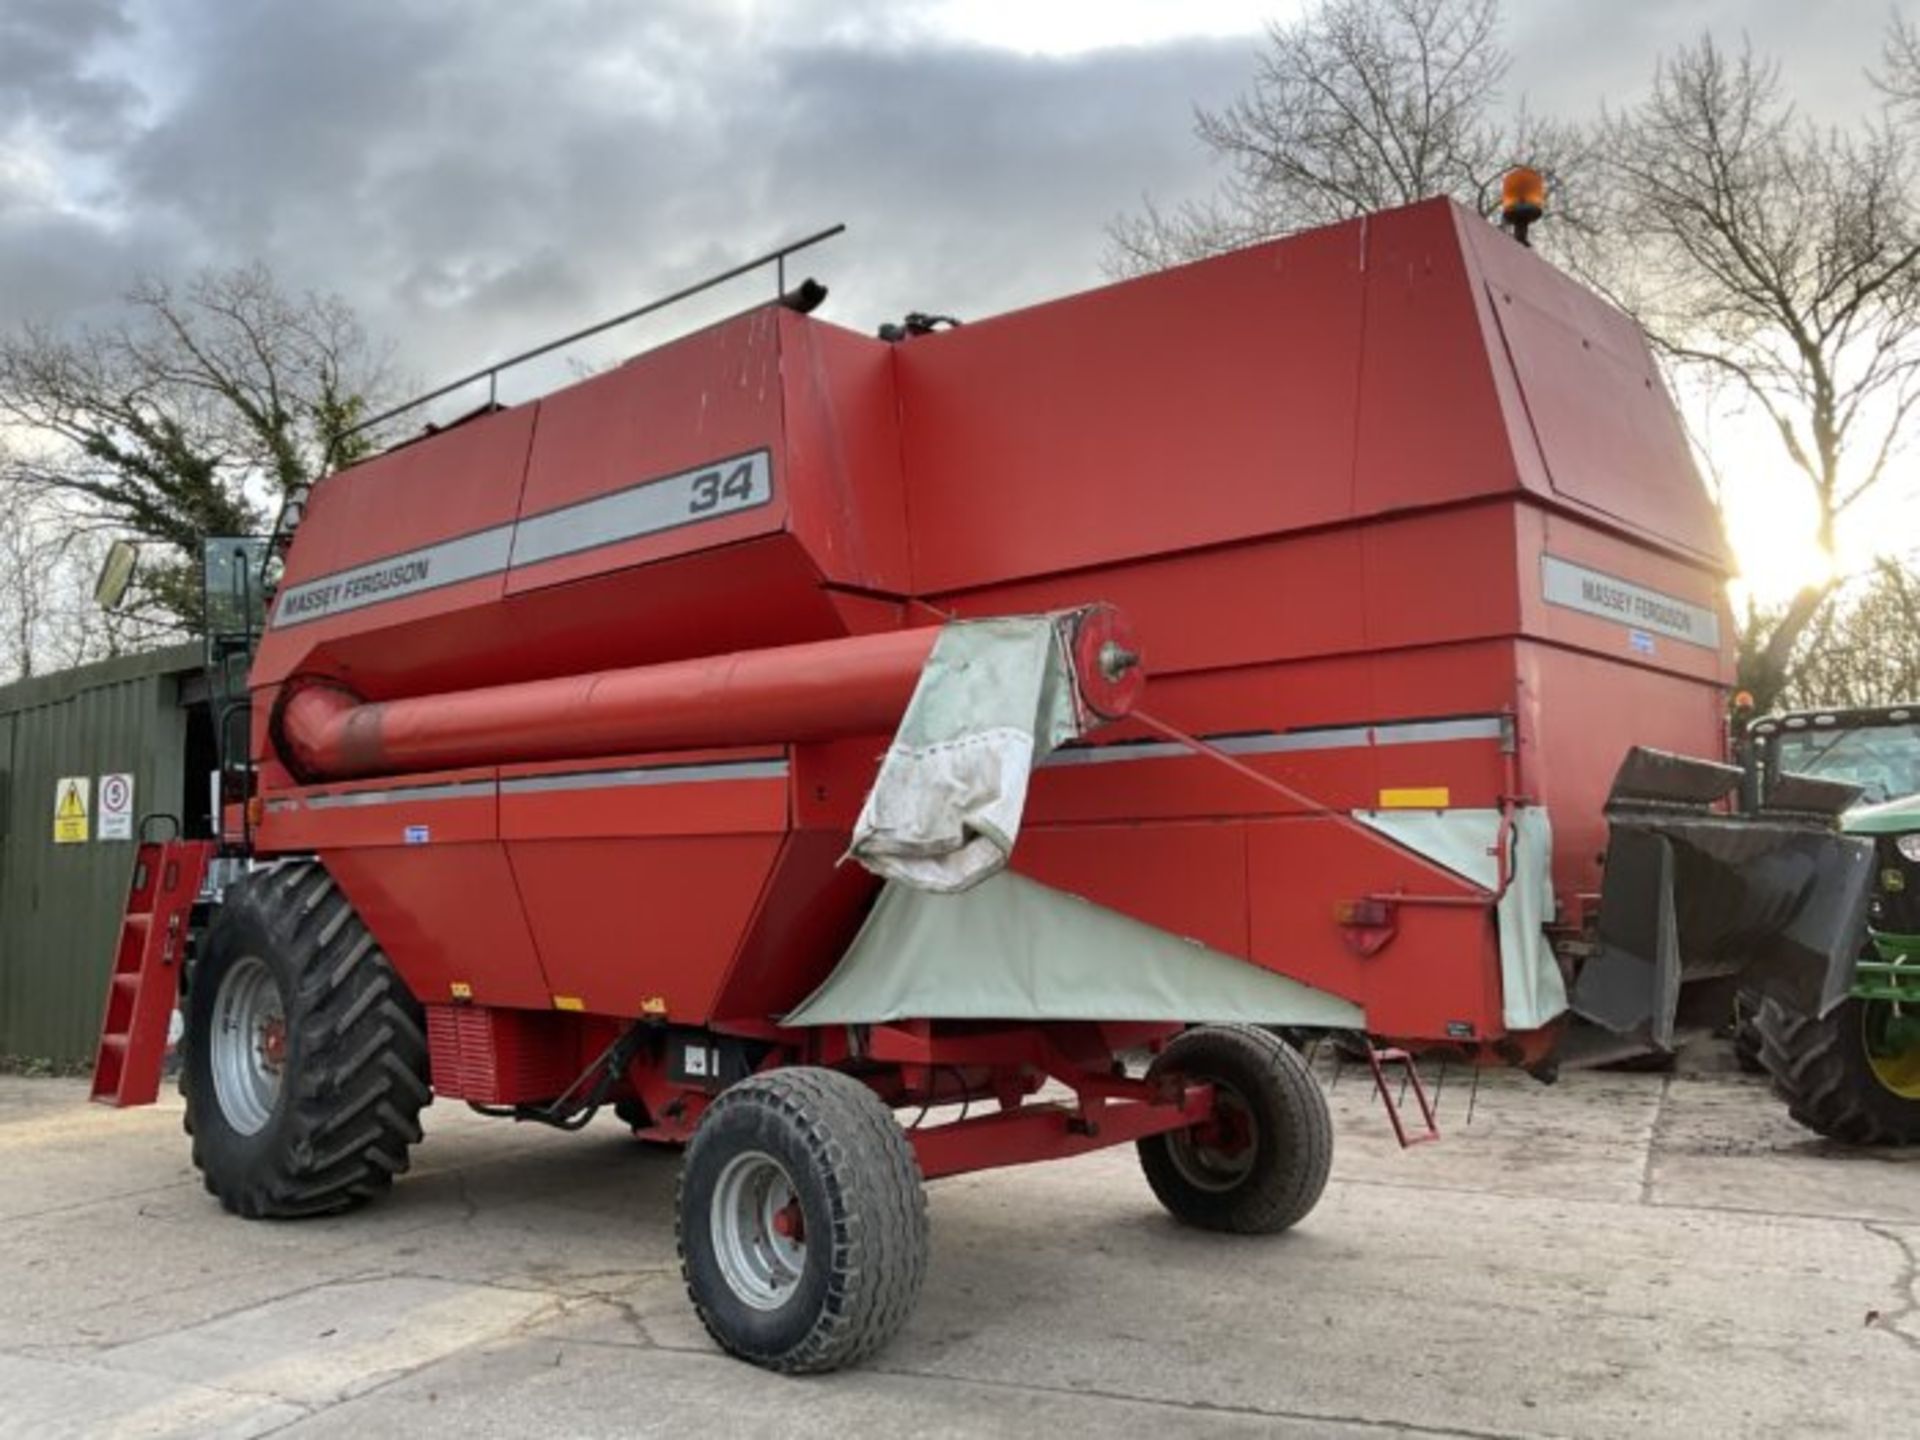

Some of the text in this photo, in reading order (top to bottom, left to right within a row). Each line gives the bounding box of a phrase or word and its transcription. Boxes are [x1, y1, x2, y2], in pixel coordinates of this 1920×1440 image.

[690, 462, 753, 513] 34
[283, 560, 429, 616] MASSEY FERGUSON
[1582, 579, 1691, 634] MASSEY FERGUSON
